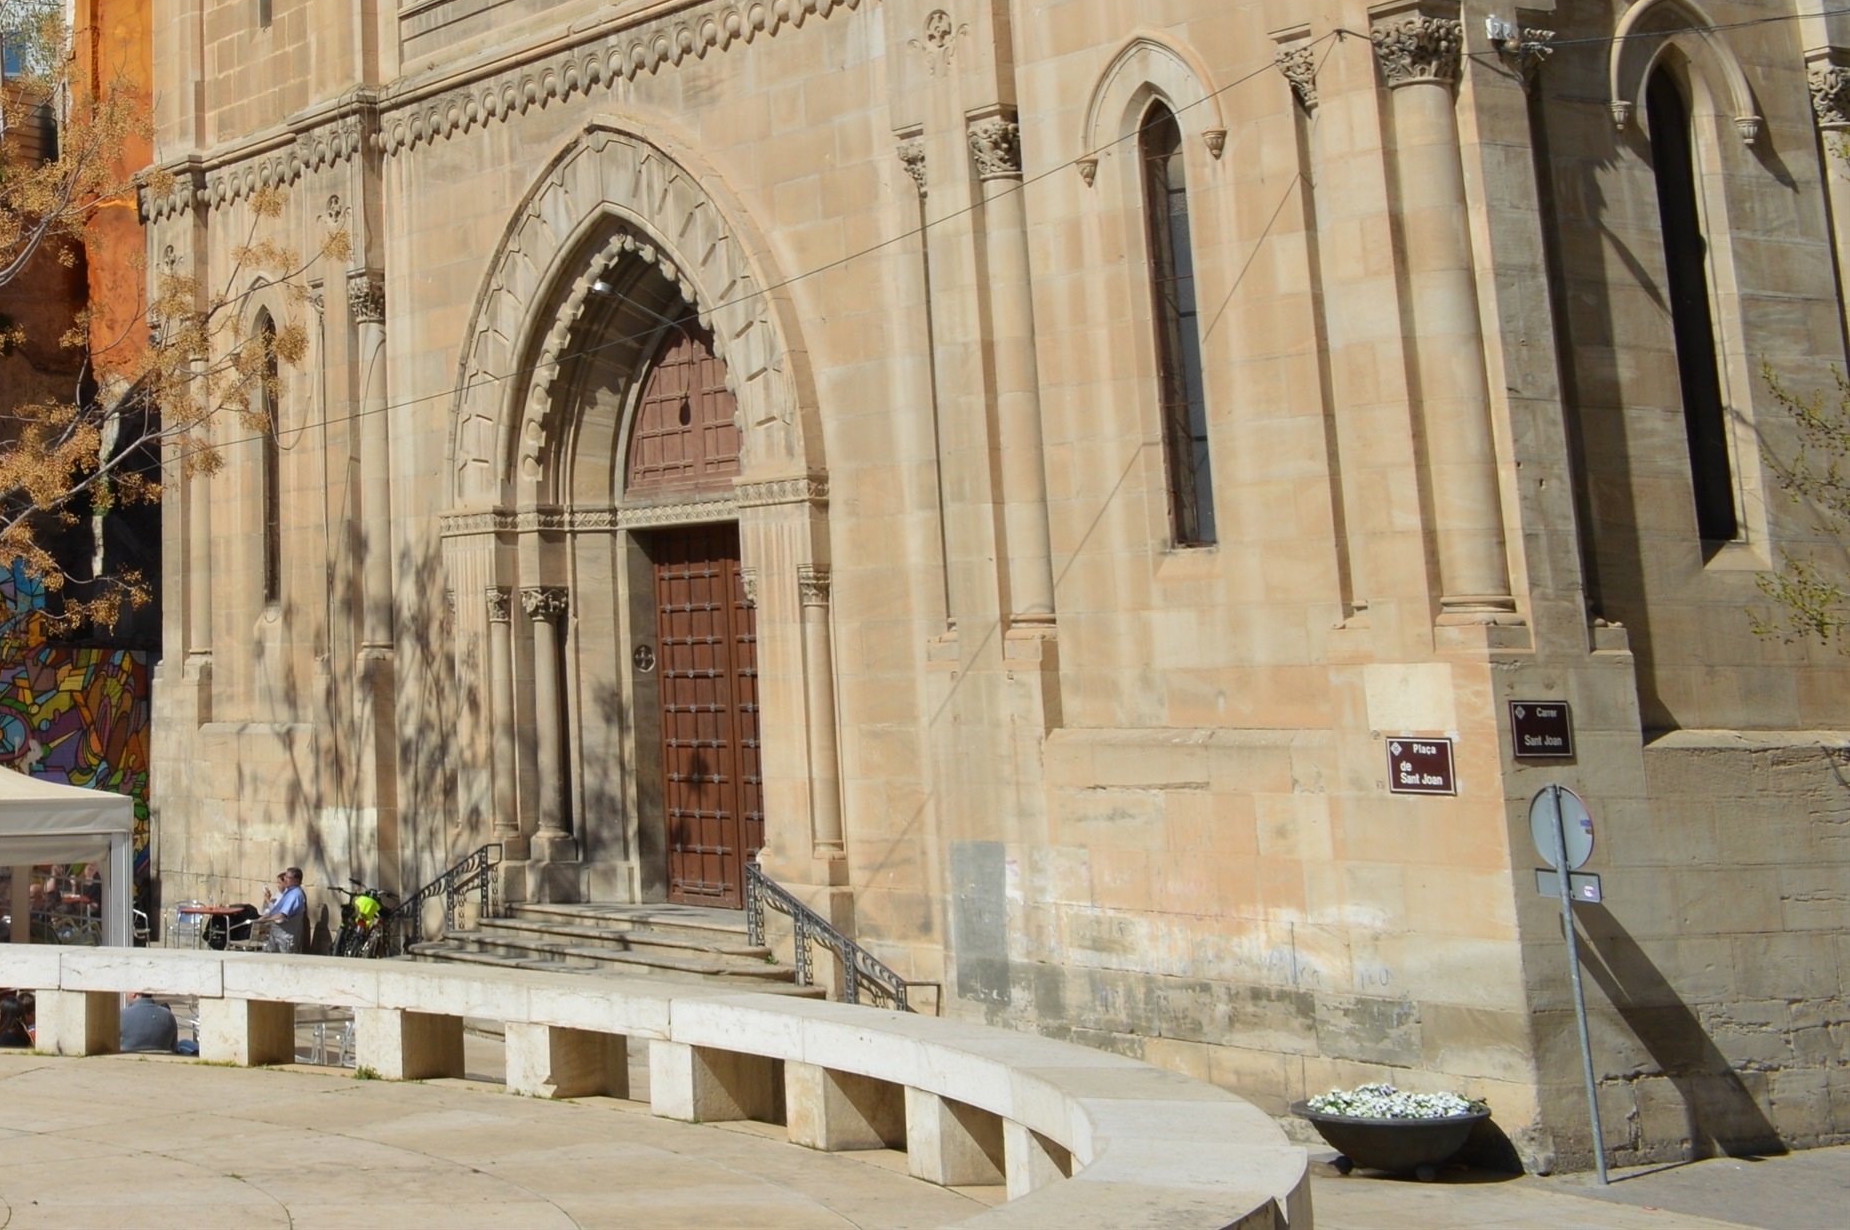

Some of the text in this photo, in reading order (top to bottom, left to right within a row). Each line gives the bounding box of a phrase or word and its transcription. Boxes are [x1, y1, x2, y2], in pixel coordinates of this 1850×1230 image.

[1535, 707, 1558, 718] Carrer
[1524, 734, 1563, 746] Sant Joan
[1412, 743, 1437, 755] Plaça
[1400, 760, 1412, 772] de
[1400, 772, 1443, 786] Sant Joan
